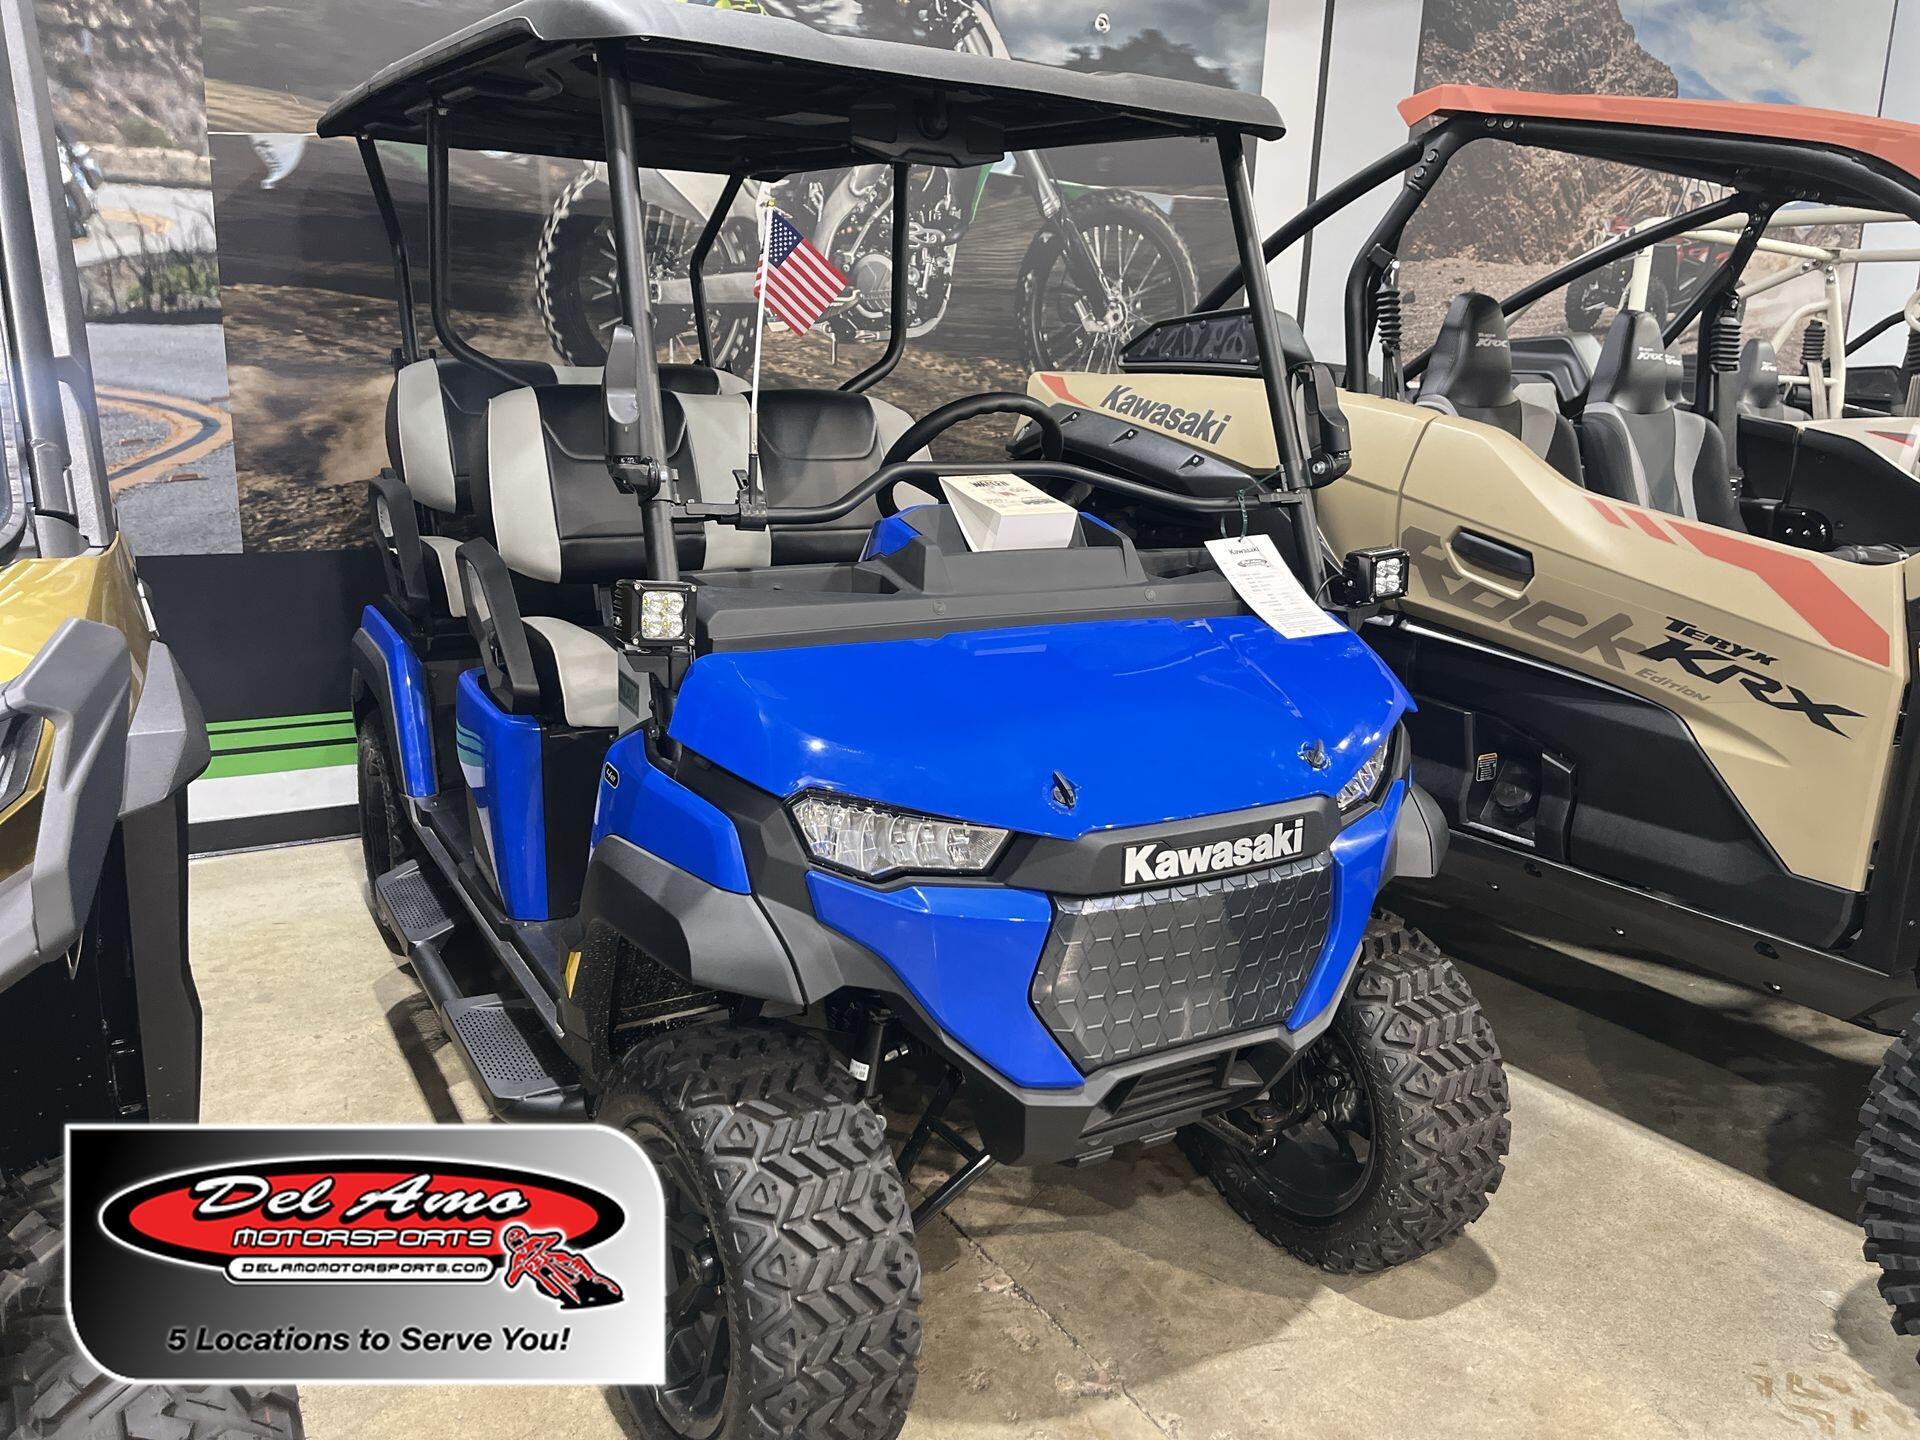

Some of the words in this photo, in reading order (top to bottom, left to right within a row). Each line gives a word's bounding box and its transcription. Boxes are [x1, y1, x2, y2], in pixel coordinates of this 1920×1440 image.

[1100, 385, 1232, 444] Kawasaki
[1401, 526, 1646, 670] Rock
[1637, 634, 1867, 739] KRX
[1124, 818, 1304, 885] Kawasaki
